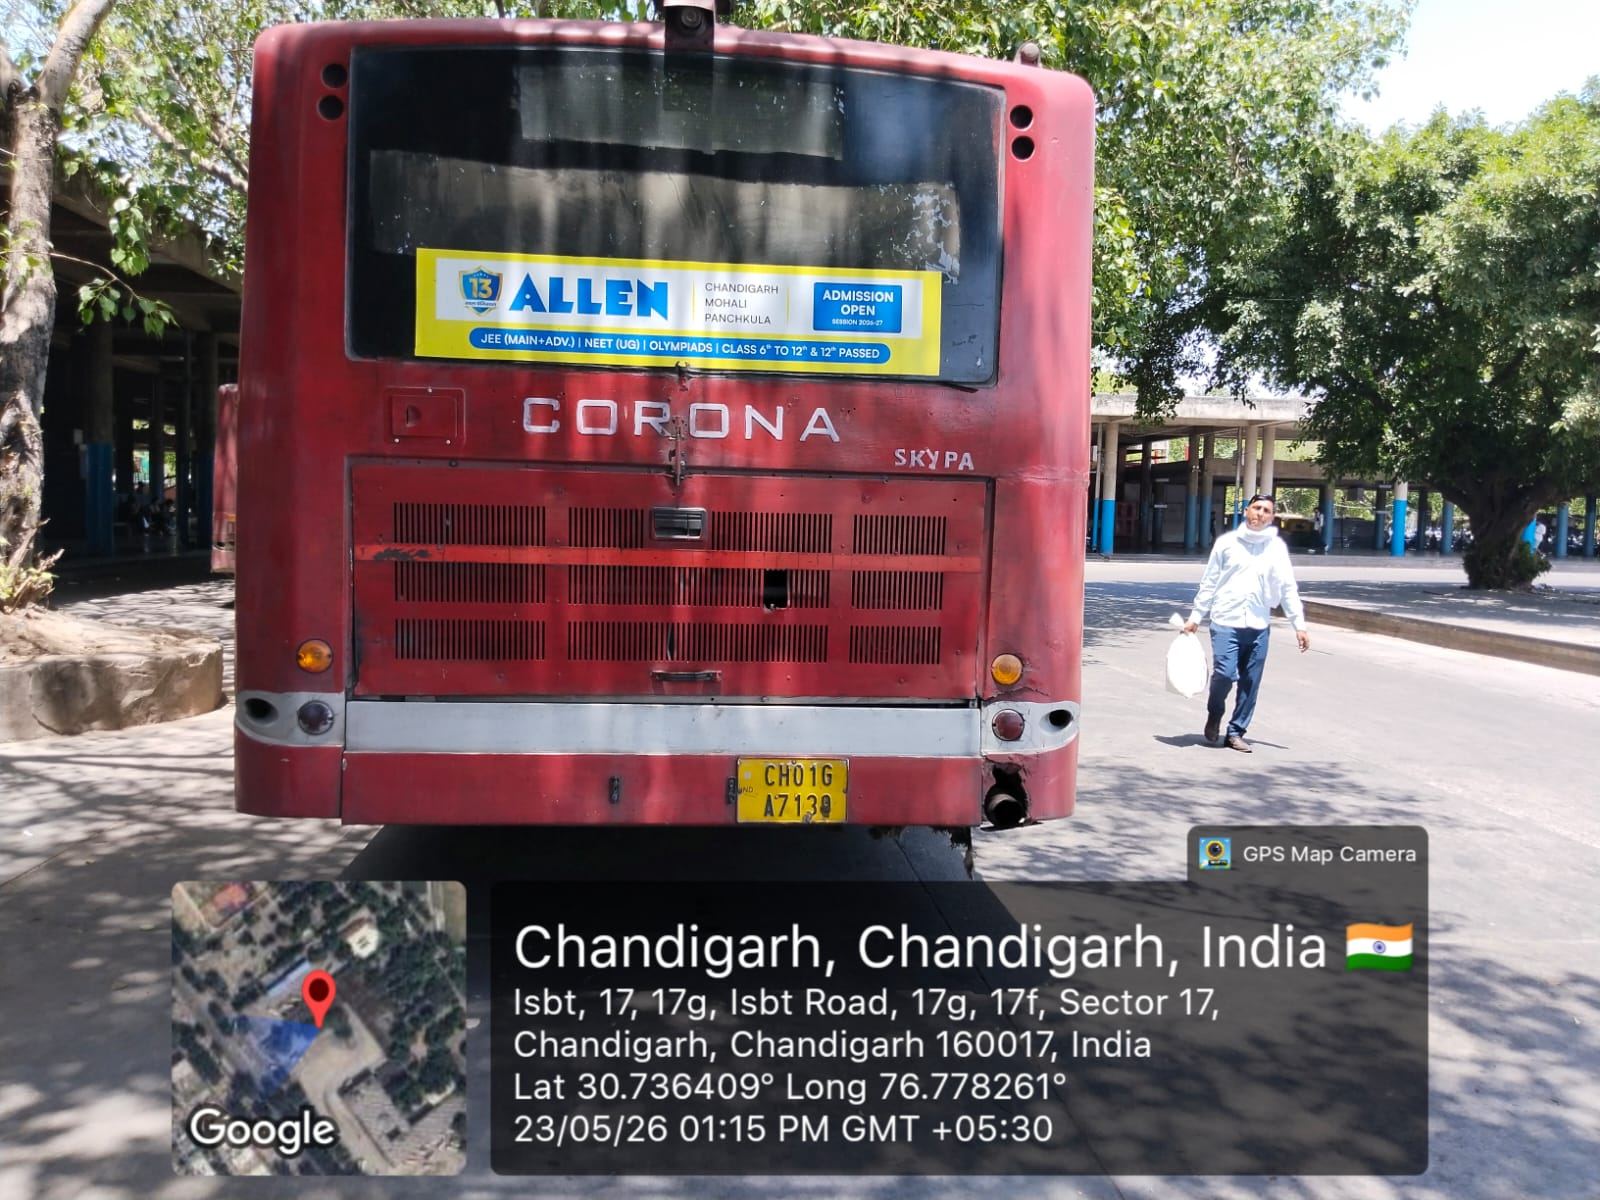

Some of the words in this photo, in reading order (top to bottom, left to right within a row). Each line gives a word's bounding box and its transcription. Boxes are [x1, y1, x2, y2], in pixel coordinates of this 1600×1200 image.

[469, 278, 493, 299] 13
[704, 282, 779, 295] CHANDIGARH
[509, 272, 668, 321] ALLEN
[822, 289, 894, 303] ADMISSION
[704, 298, 747, 309] MOHALI
[840, 304, 875, 316] OPEN
[704, 313, 771, 325] PANCHKULA
[831, 318, 858, 326] SESSION
[481, 333, 502, 344] JEE
[504, 333, 576, 349] (MAIN+ADV.)
[584, 337, 614, 349] NEET
[616, 338, 641, 351] (UG)
[649, 340, 713, 353] OLYMPIADS
[722, 343, 757, 355] CLASS
[774, 345, 789, 356] TO
[810, 347, 819, 357] &
[838, 348, 881, 359] PASSED
[522, 397, 841, 443] CORONA
[764, 764, 833, 787] CH01G
